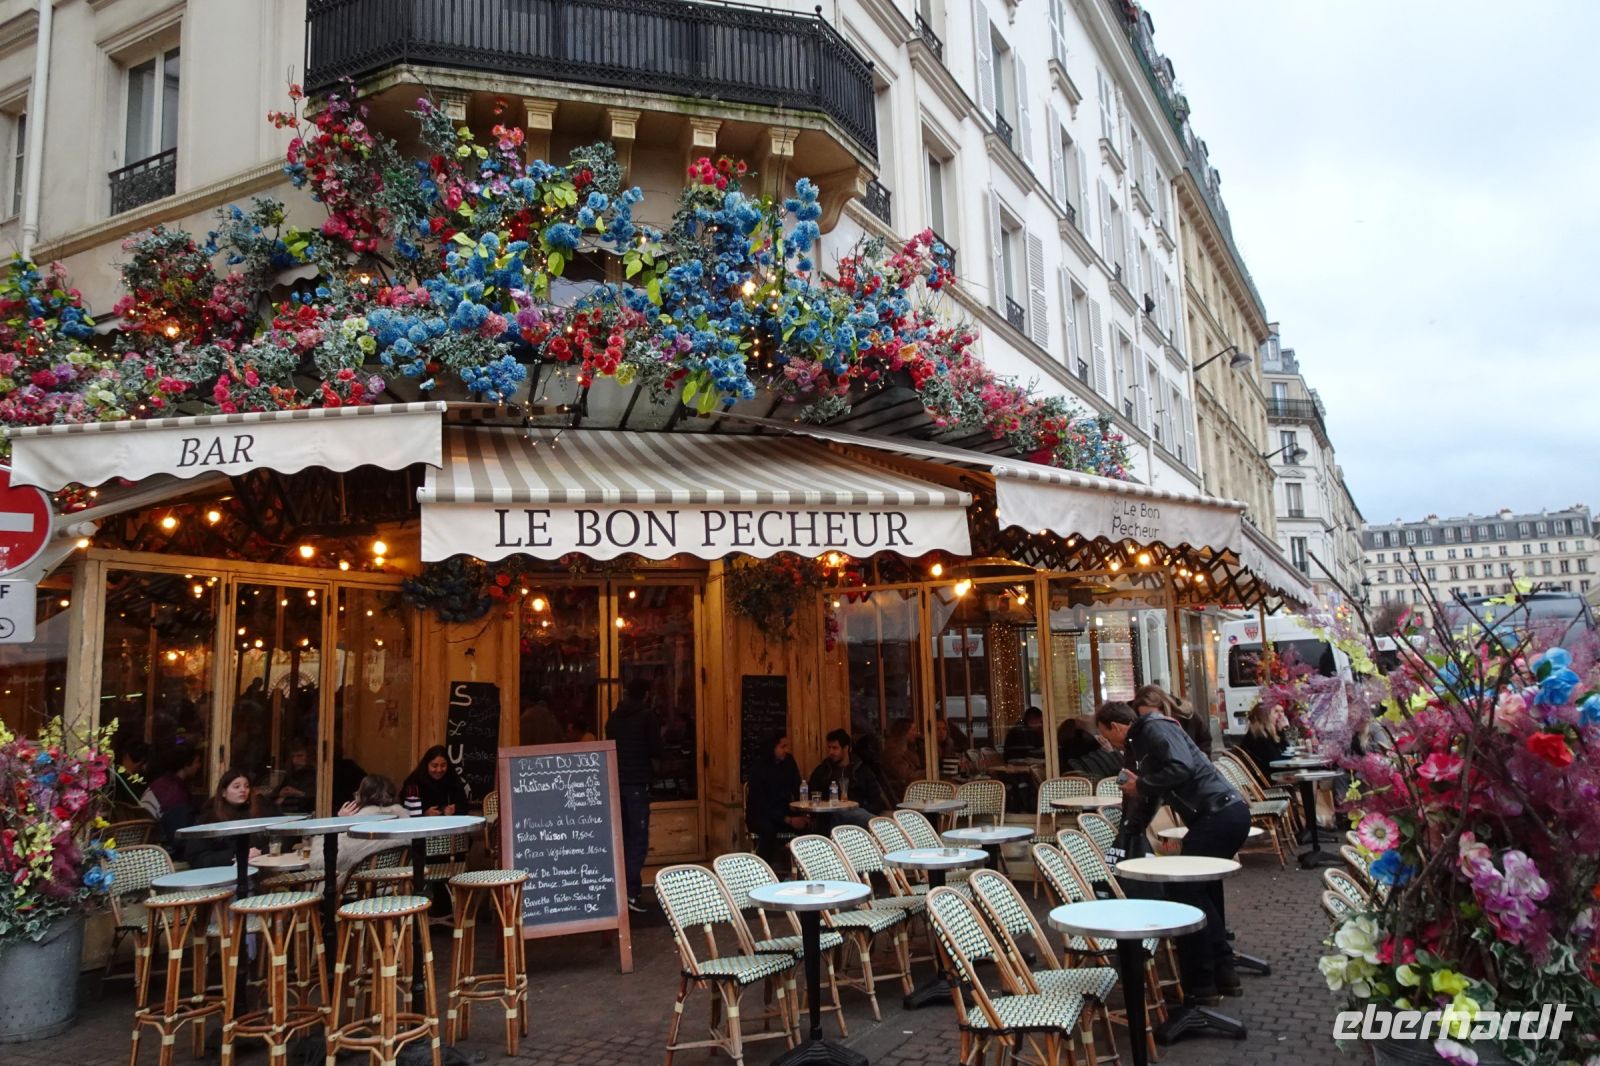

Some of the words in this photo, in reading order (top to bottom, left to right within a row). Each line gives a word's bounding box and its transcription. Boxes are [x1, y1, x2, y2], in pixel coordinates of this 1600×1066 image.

[177, 434, 254, 467] BAR
[1123, 500, 1136, 516] Le
[1140, 502, 1160, 519] Bon
[494, 509, 552, 548] LE
[574, 509, 680, 548] BON
[700, 510, 913, 548] PECHEUR
[1111, 515, 1159, 538] Pecheur
[518, 756, 554, 770] PLAT
[556, 755, 572, 769] DU
[556, 815, 563, 826] à
[565, 815, 575, 825] la
[539, 829, 567, 841] Maison
[524, 848, 544, 859] Pizza
[584, 903, 599, 913] 19€
